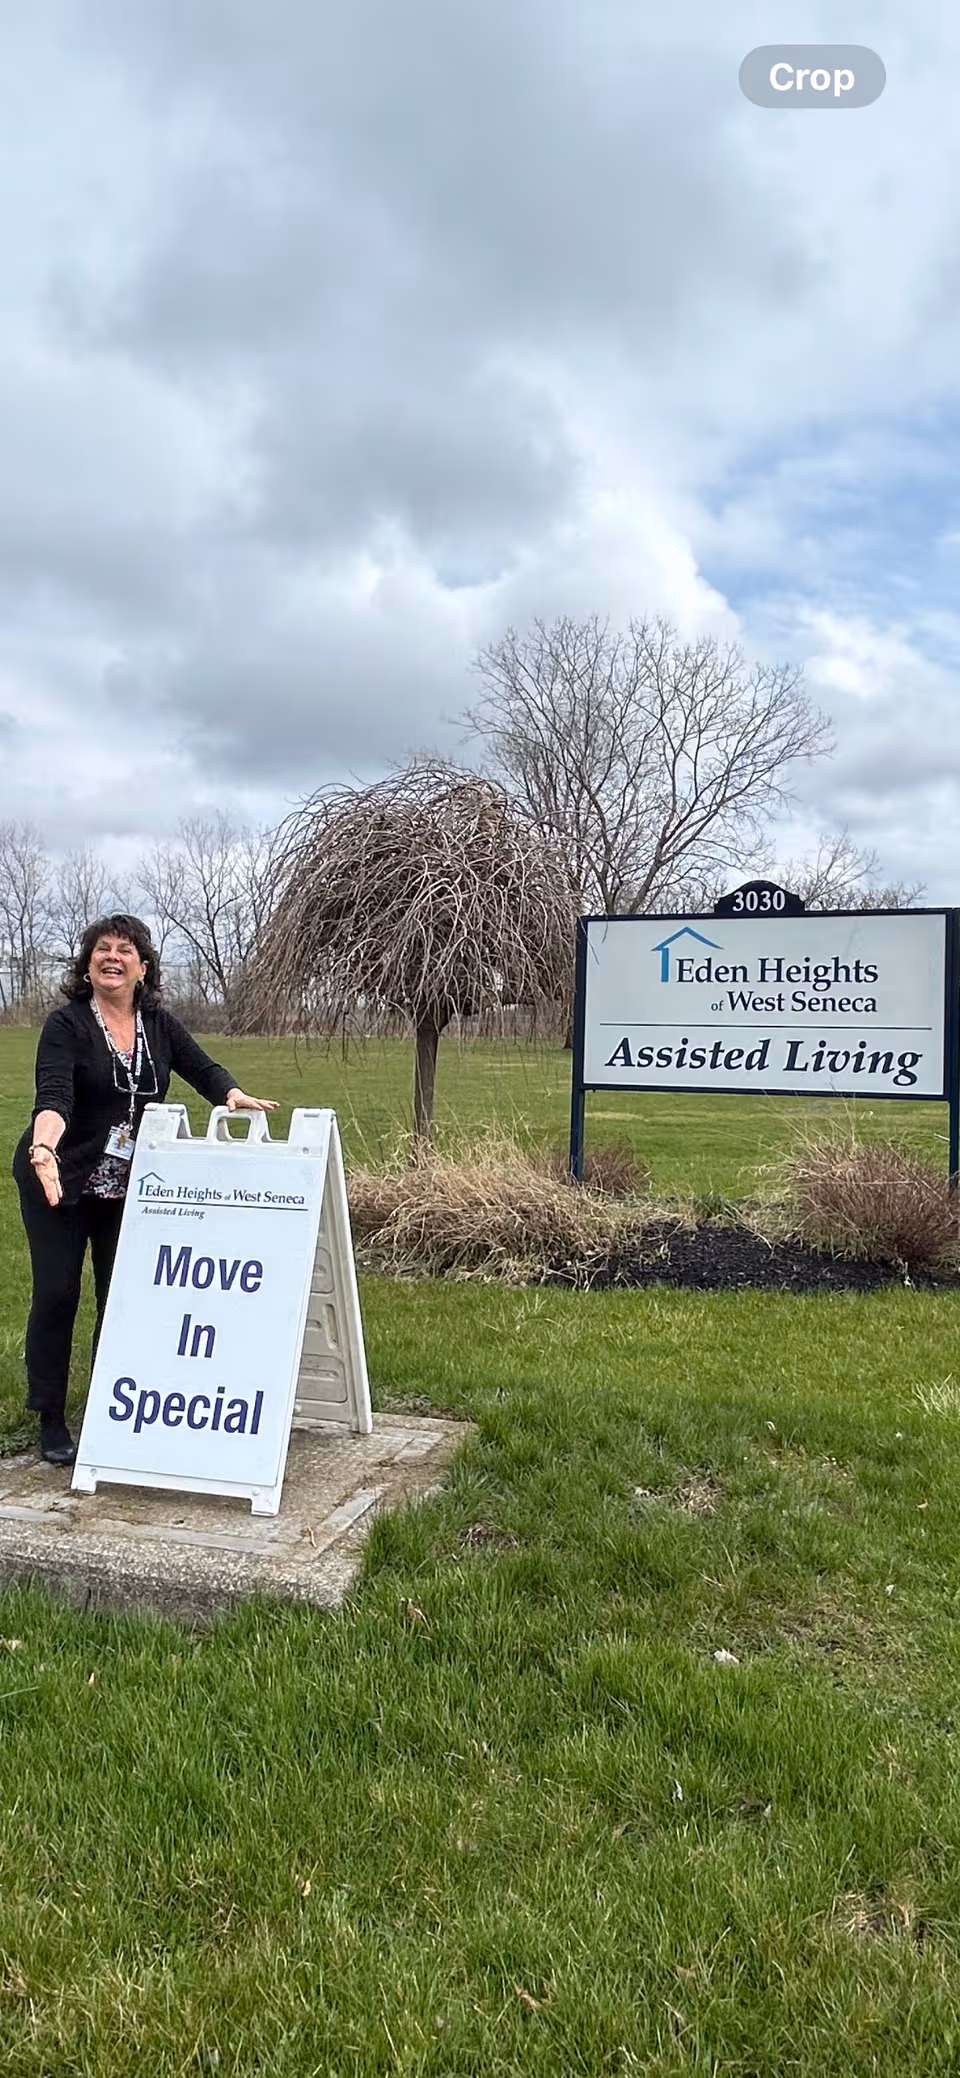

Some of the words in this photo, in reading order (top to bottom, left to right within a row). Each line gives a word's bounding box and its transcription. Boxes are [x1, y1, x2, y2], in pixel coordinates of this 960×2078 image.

[732, 889, 786, 912] 3030
[675, 957, 750, 984] Eden
[757, 956, 879, 992] Heights
[710, 999, 725, 1012] of
[726, 990, 785, 1013] West
[790, 990, 878, 1013] Seneca
[604, 1037, 771, 1071] Assisted
[783, 1040, 923, 1086] Living
[141, 1206, 177, 1216] Assisted
[178, 1207, 206, 1219] Living
[145, 1184, 174, 1198] Eden
[177, 1186, 223, 1203] Heights
[232, 1189, 262, 1203] West
[263, 1190, 305, 1205] Seneca
[153, 1244, 264, 1293] Move
[176, 1313, 217, 1359] In
[108, 1376, 265, 1436] Special
